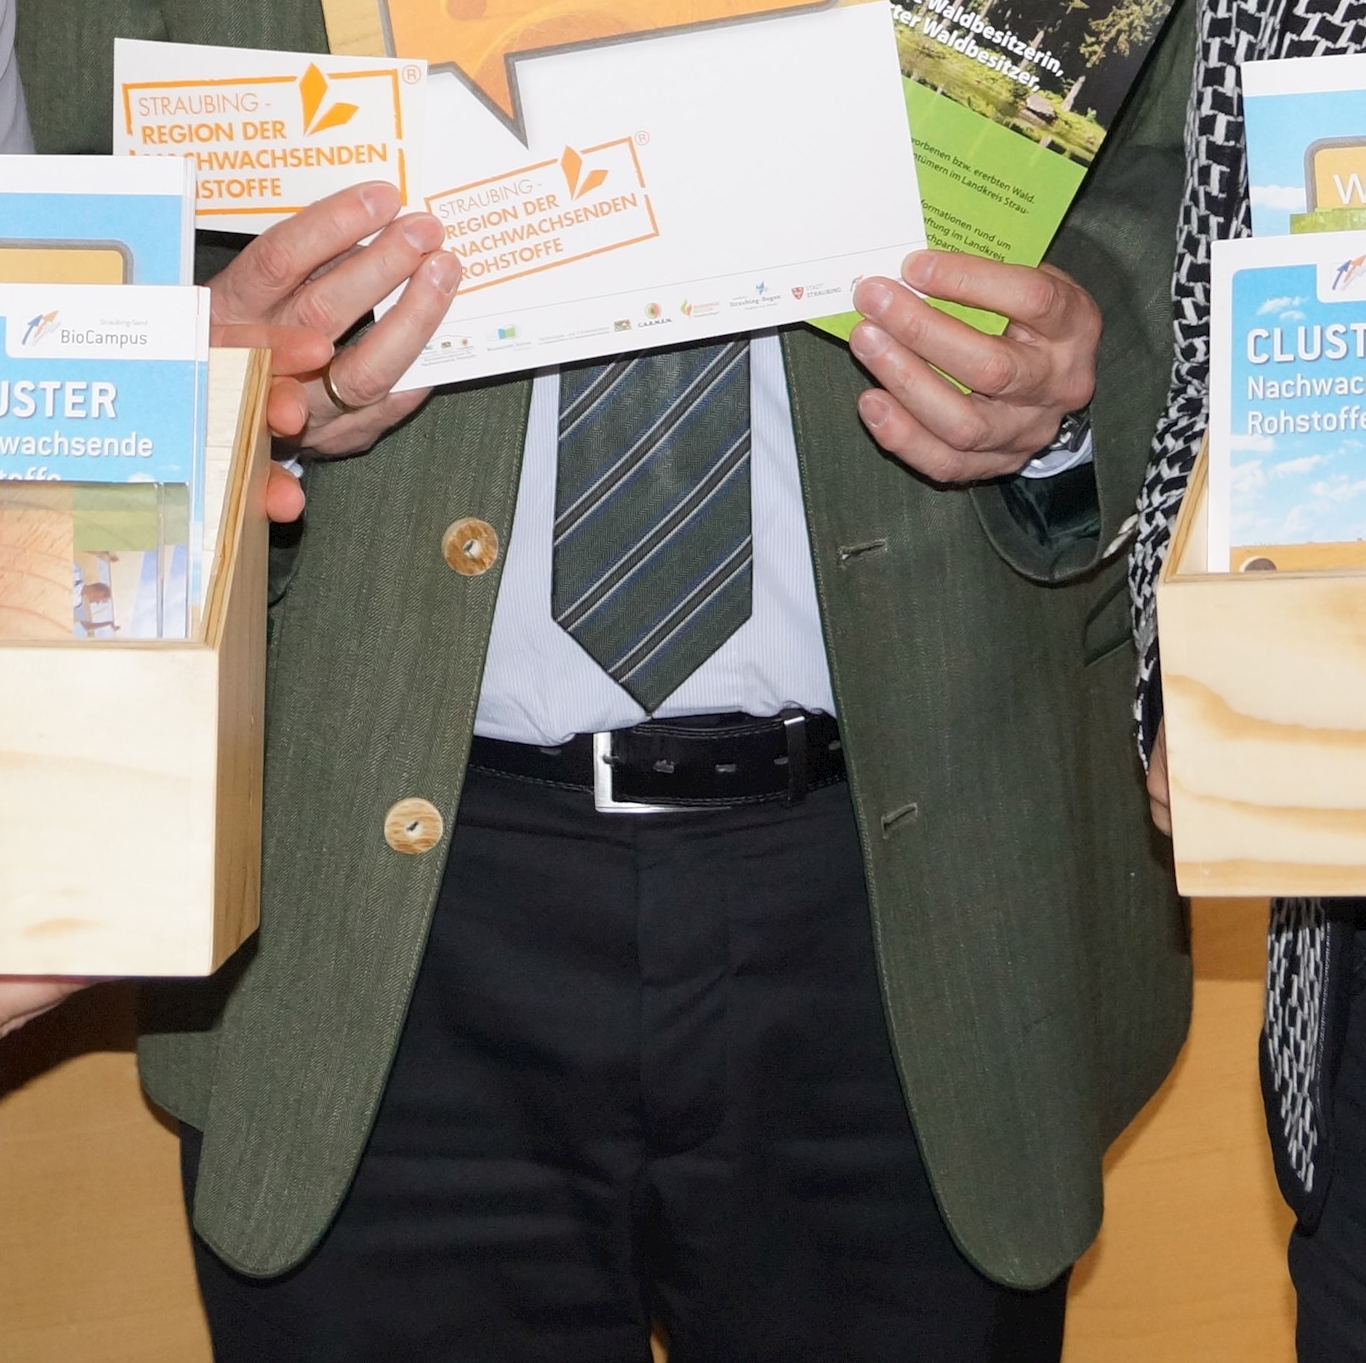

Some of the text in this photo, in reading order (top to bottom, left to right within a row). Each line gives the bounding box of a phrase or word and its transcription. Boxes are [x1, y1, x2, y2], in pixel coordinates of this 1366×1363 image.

[923, 17, 1040, 92] Waldbesitzer,
[139, 93, 259, 117] STRAUBING
[141, 120, 287, 144] REGION DER
[143, 143, 387, 170] HWACHSENDEN
[196, 177, 282, 199] STOFFE
[950, 171, 961, 181] im
[962, 177, 1003, 203] Landkreis
[1003, 197, 1029, 215] Strau-
[952, 156, 971, 172] bzw.
[973, 169, 1011, 192] ererbten
[1012, 186, 1035, 204] Wald.
[438, 179, 533, 219] STRAUBING
[445, 194, 559, 239] REGION DER
[451, 193, 638, 258] NACHWACHSENDEN
[974, 227, 996, 243] rund
[996, 239, 1011, 251] um
[461, 238, 563, 280] ROHSTOFFE
[951, 229, 963, 241] im
[964, 236, 1006, 262] Landkreis
[61, 330, 147, 348] BioCampus
